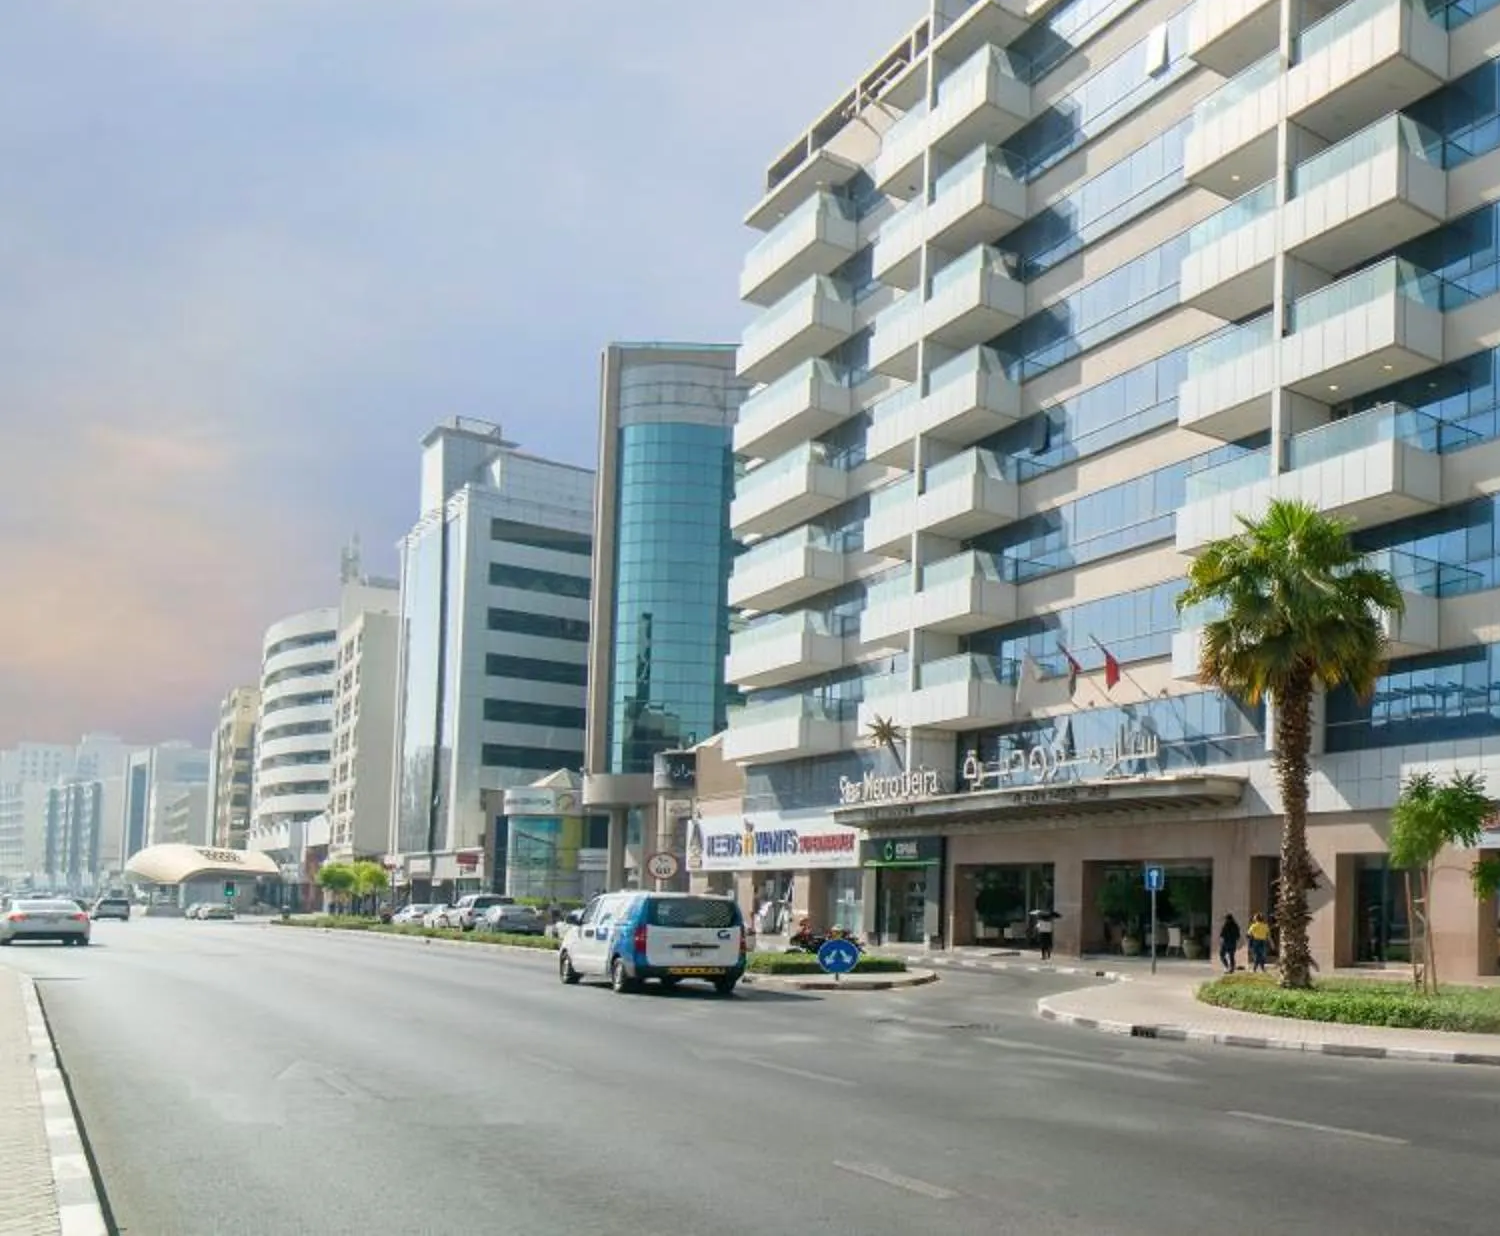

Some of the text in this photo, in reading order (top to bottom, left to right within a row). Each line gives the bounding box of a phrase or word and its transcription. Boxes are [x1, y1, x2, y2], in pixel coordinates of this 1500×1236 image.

[863, 771, 900, 801] Metro
[901, 765, 939, 798] Deira
[755, 829, 799, 855] WANTS
